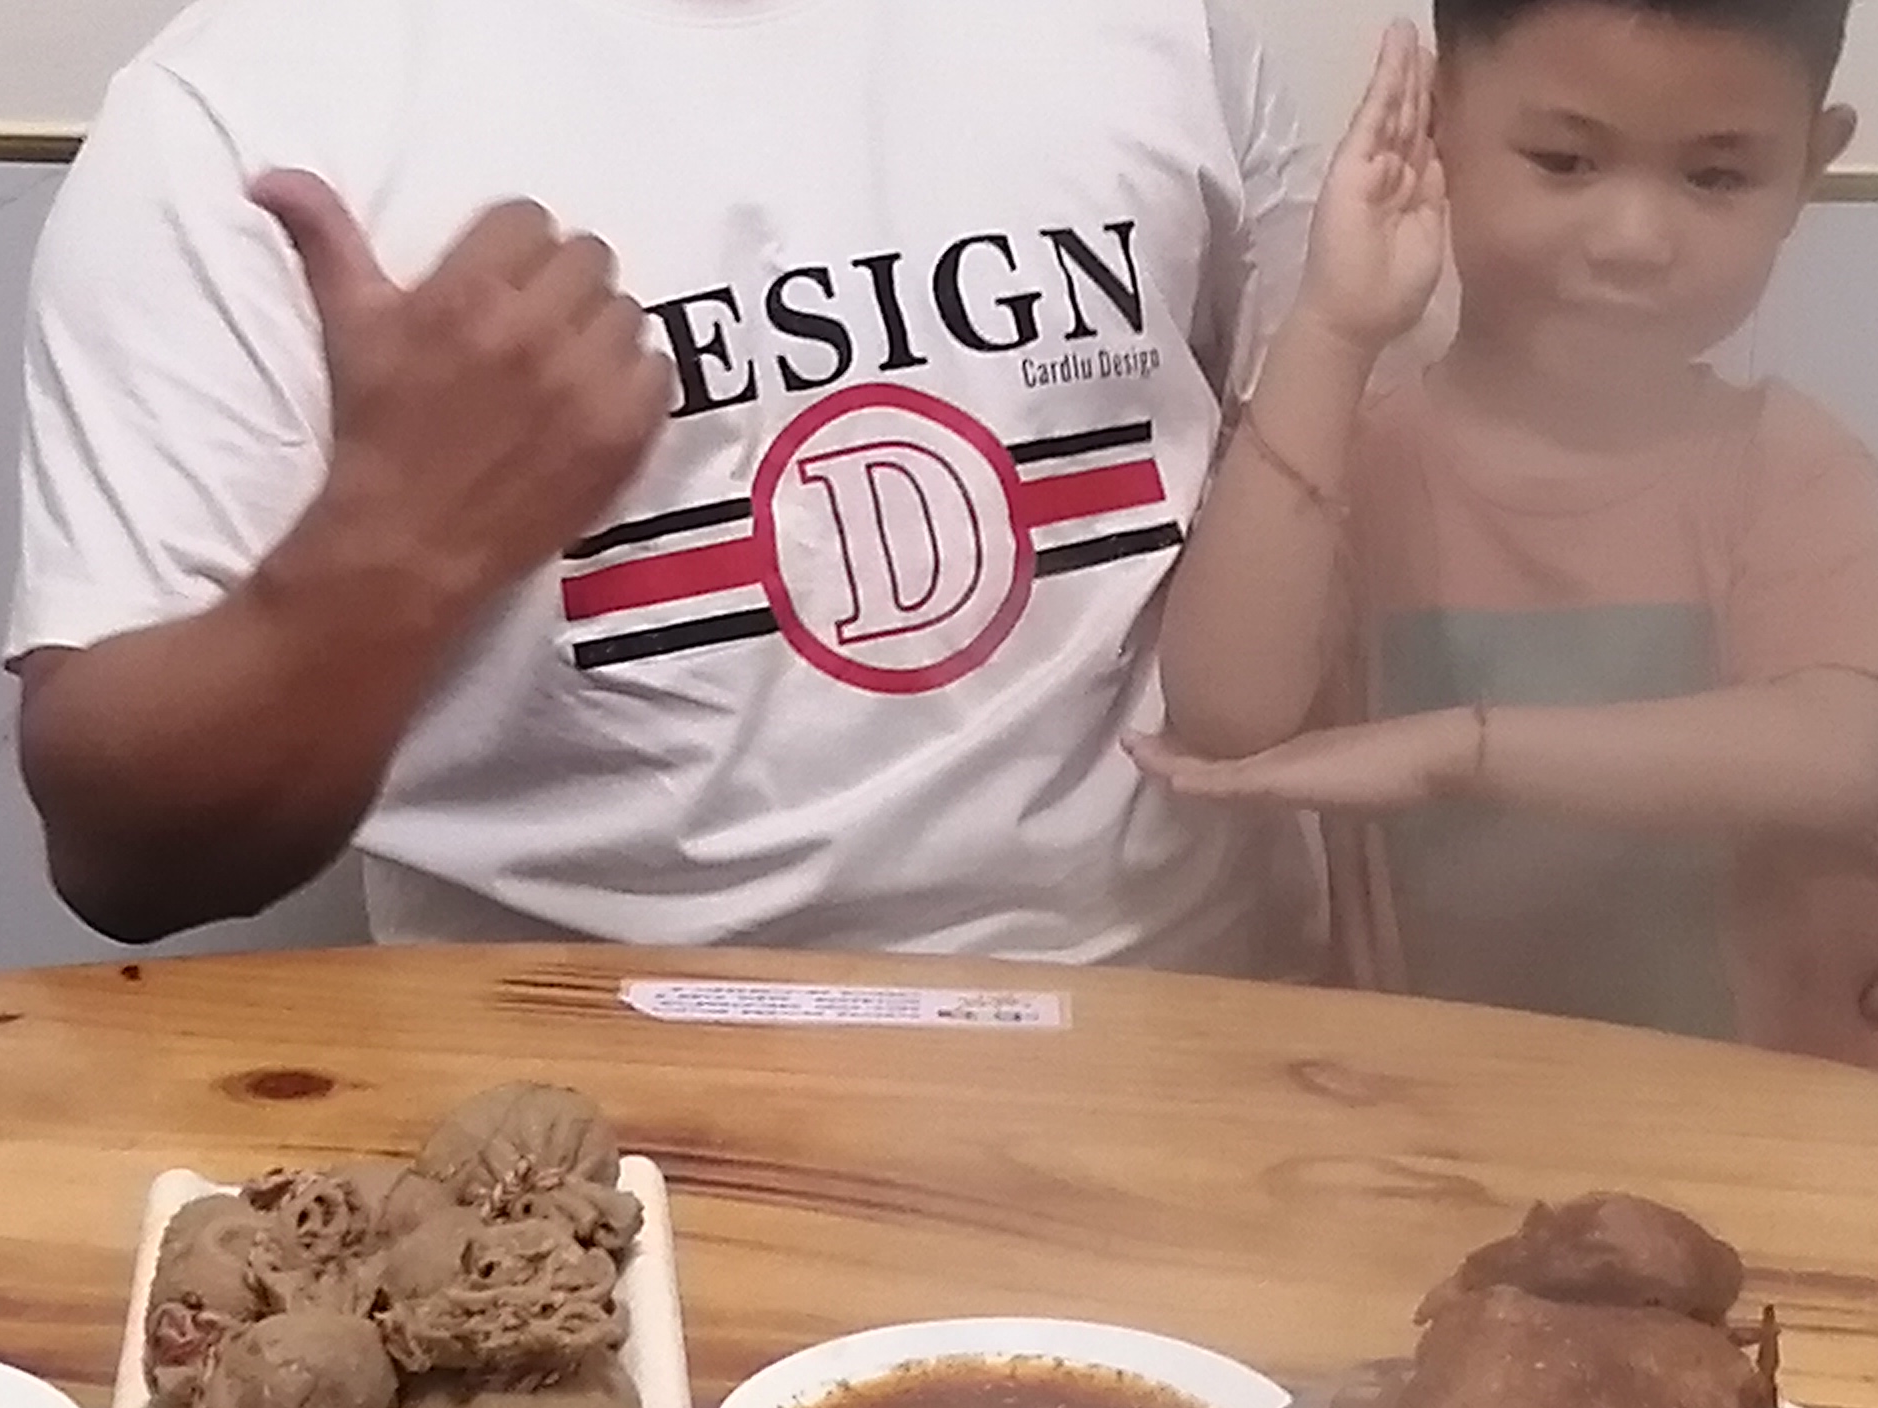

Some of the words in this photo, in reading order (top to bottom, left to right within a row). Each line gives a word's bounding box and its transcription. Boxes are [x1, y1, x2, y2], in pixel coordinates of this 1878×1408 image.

[643, 221, 1145, 419] ESIGN
[1098, 346, 1160, 379] Design
[797, 441, 984, 646] D
